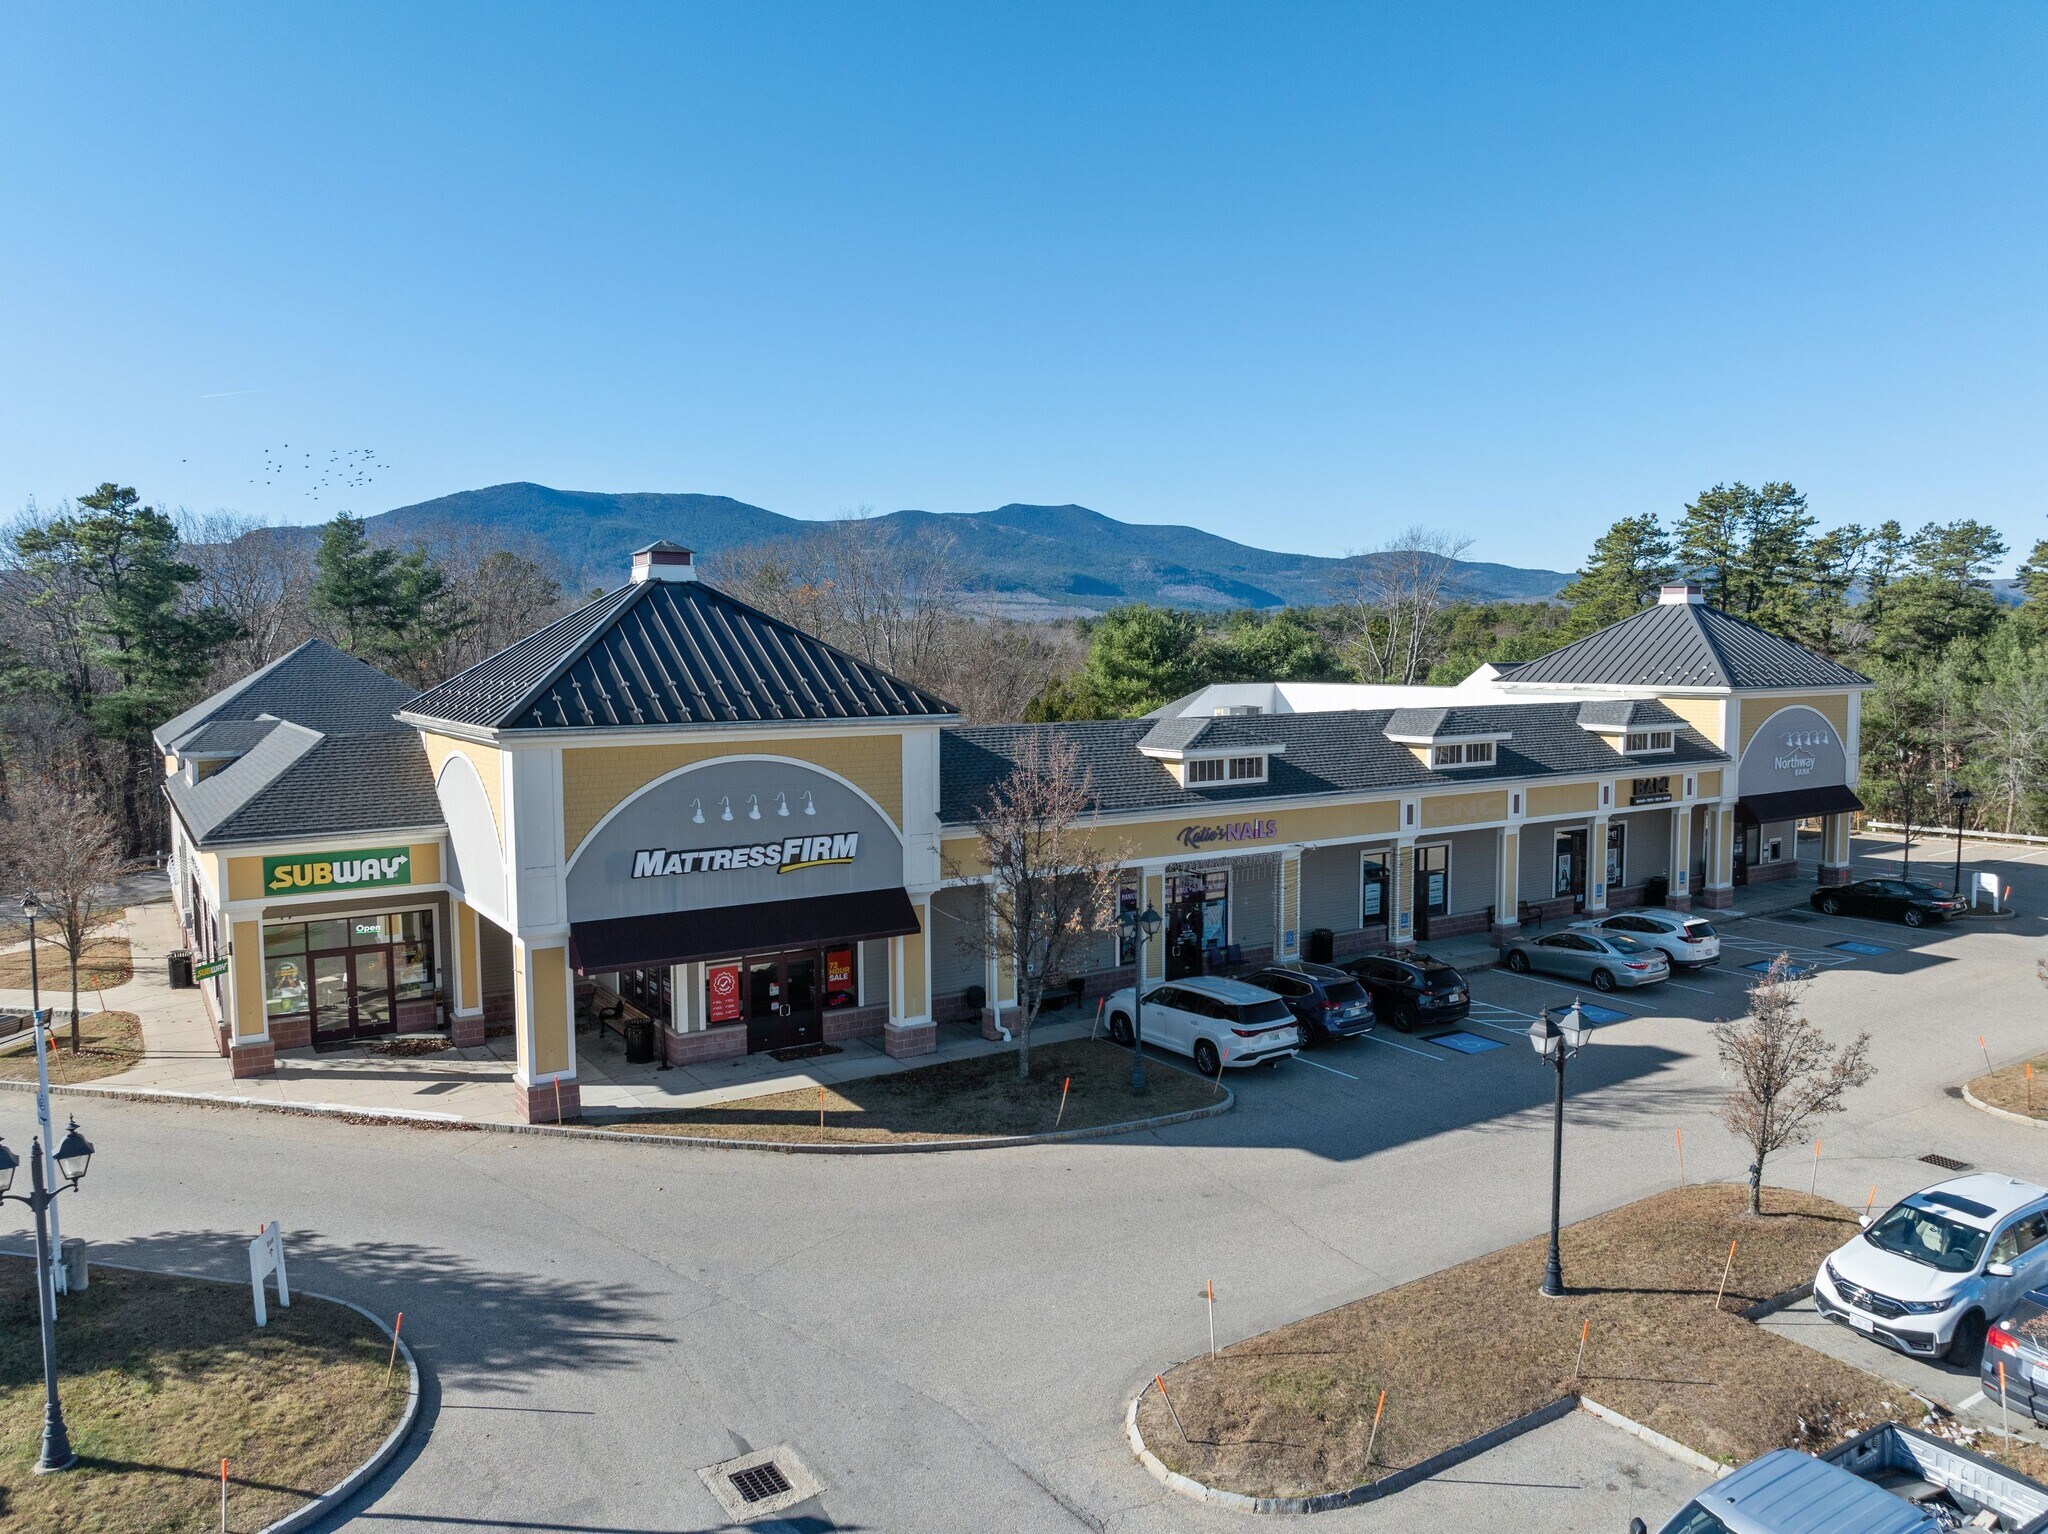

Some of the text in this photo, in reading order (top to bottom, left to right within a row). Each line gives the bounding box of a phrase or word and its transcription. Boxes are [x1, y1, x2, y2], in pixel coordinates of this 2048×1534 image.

[1774, 754, 1816, 770] Northway
[1794, 768, 1811, 777] BANK
[1632, 776, 1670, 796] BAM!
[1177, 819, 1278, 849] Katie's NAILS
[268, 854, 409, 891] SUBWAY
[355, 924, 381, 933] Open
[197, 962, 228, 978] SUBWAY
[829, 973, 848, 982] SALE
[830, 966, 850, 976] HOUR
